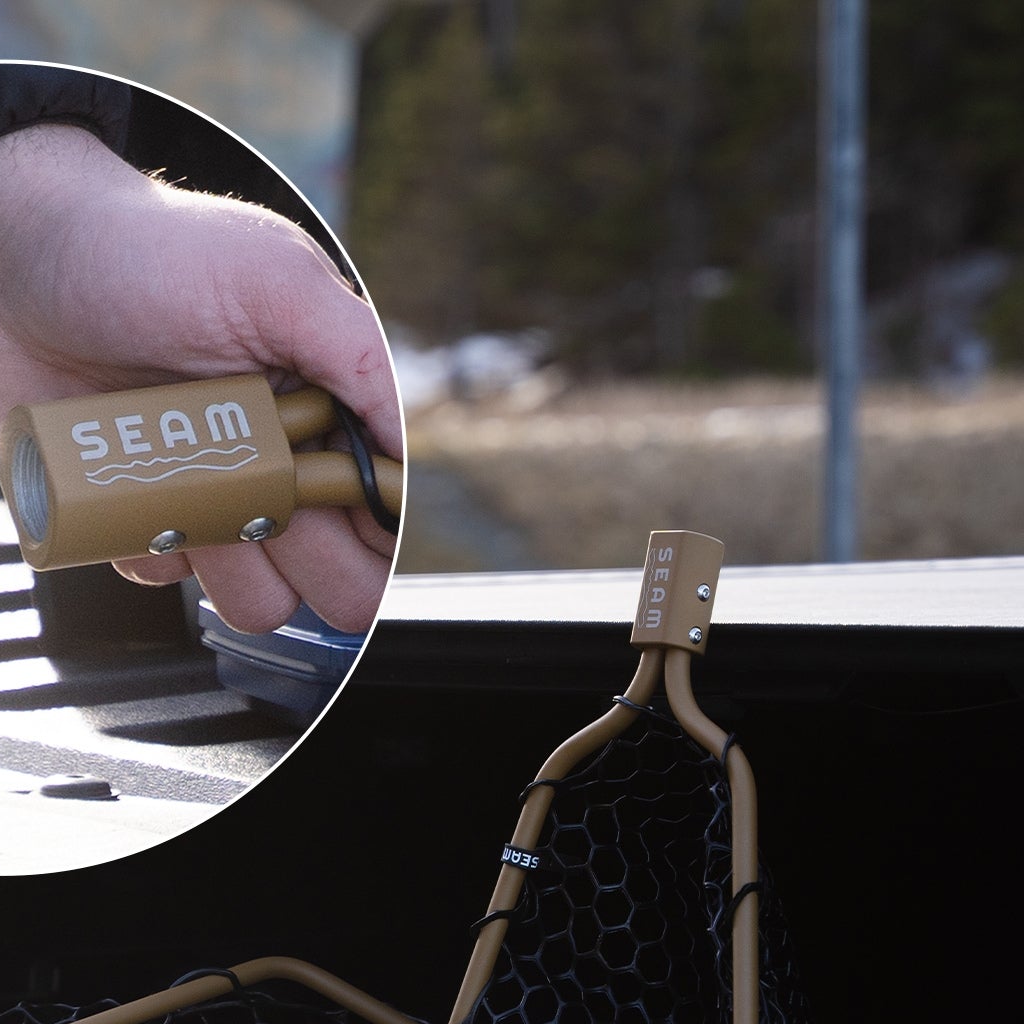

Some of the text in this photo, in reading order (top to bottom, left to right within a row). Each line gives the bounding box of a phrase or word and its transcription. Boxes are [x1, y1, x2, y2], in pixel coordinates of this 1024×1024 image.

[71, 401, 252, 461] SEAM
[645, 546, 673, 629] SEAM
[502, 846, 540, 869] SEAM
